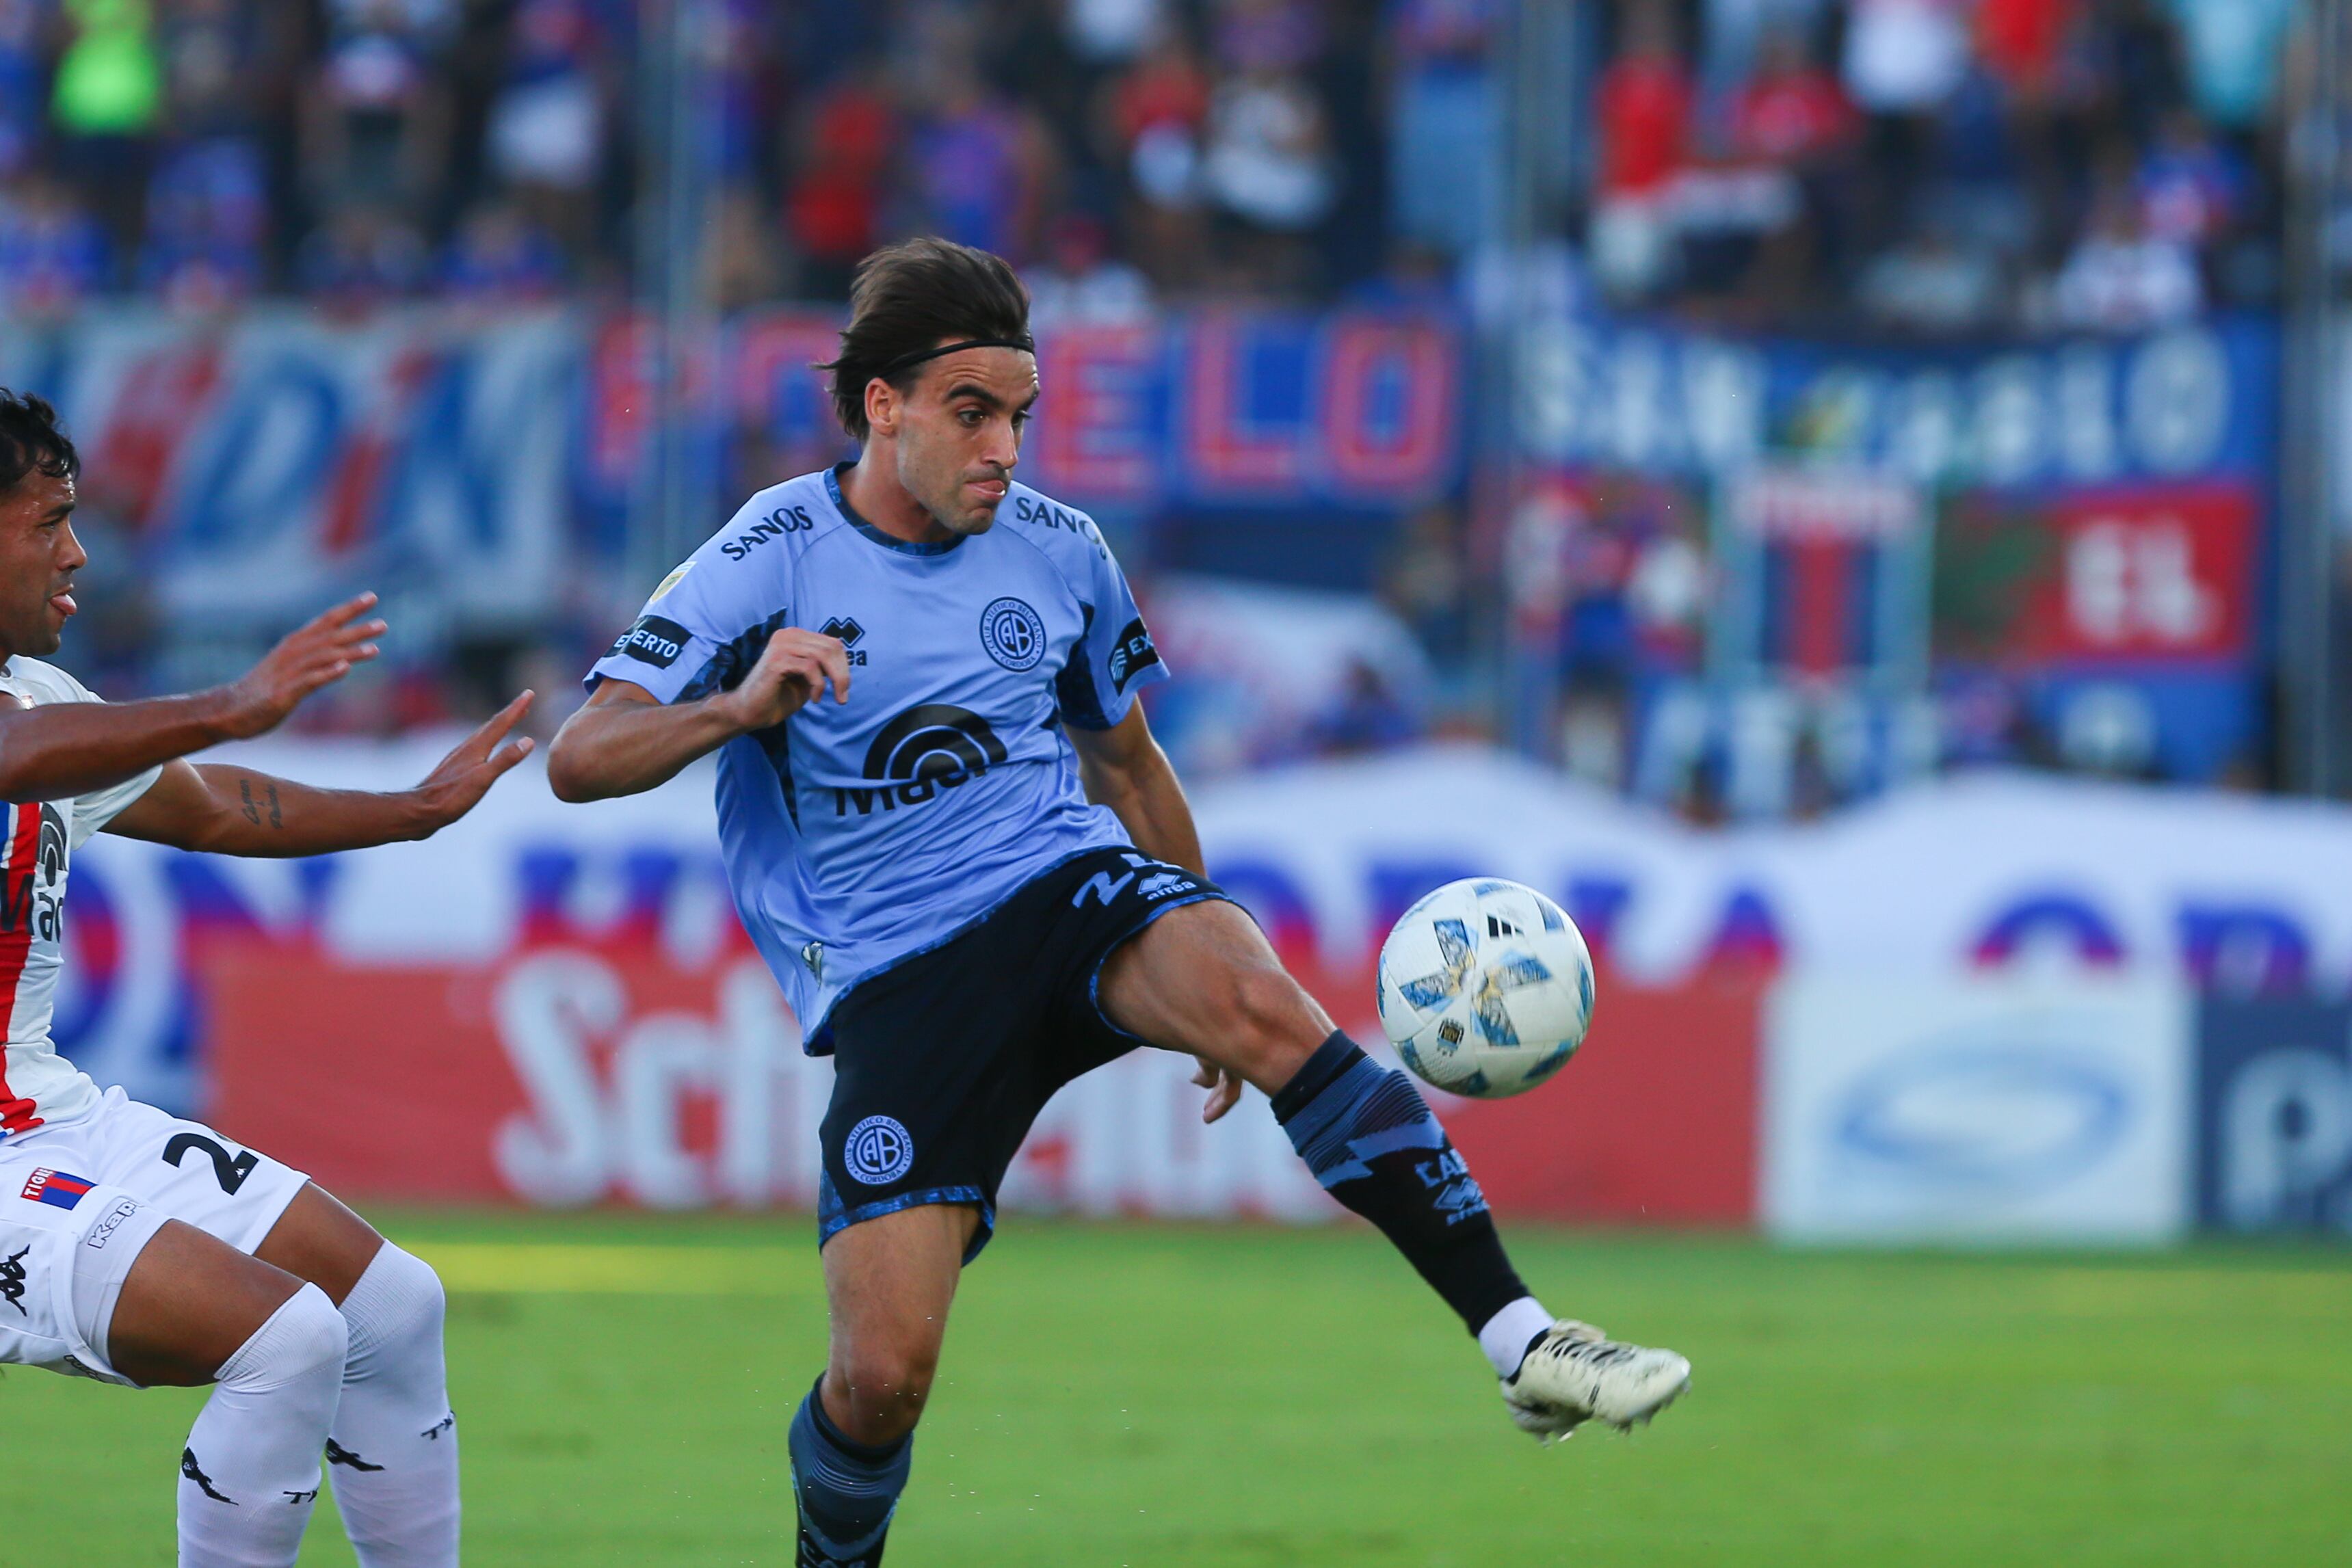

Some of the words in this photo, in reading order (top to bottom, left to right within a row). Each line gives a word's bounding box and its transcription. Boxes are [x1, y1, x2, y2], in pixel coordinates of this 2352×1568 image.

[721, 505, 813, 561] SANOS
[886, 1118, 912, 1161] BELGRANO
[860, 1169, 902, 1183] CORDOBA
